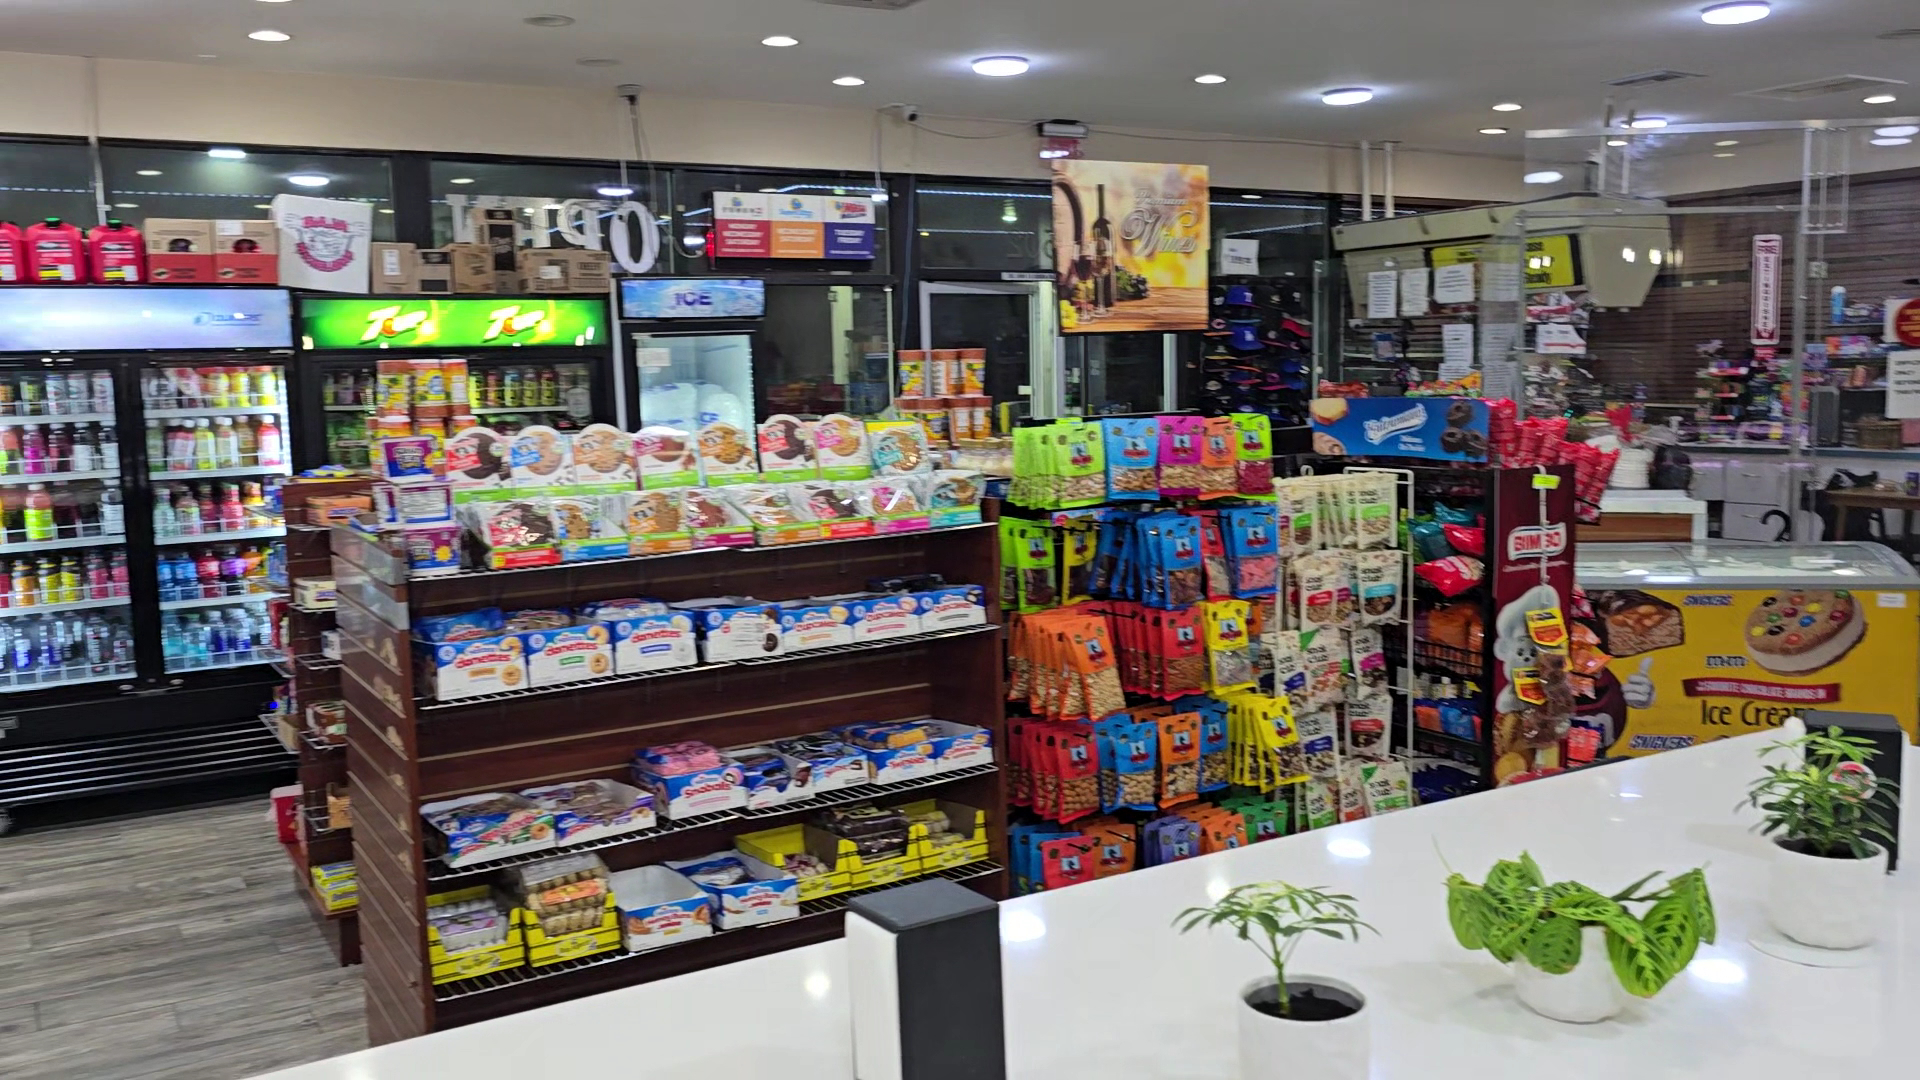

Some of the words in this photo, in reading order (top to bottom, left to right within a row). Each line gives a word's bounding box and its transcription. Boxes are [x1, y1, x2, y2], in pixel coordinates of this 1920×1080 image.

[1121, 208, 1199, 257] Wines
[674, 290, 714, 306] ICE
[1702, 700, 1731, 725] Ice
